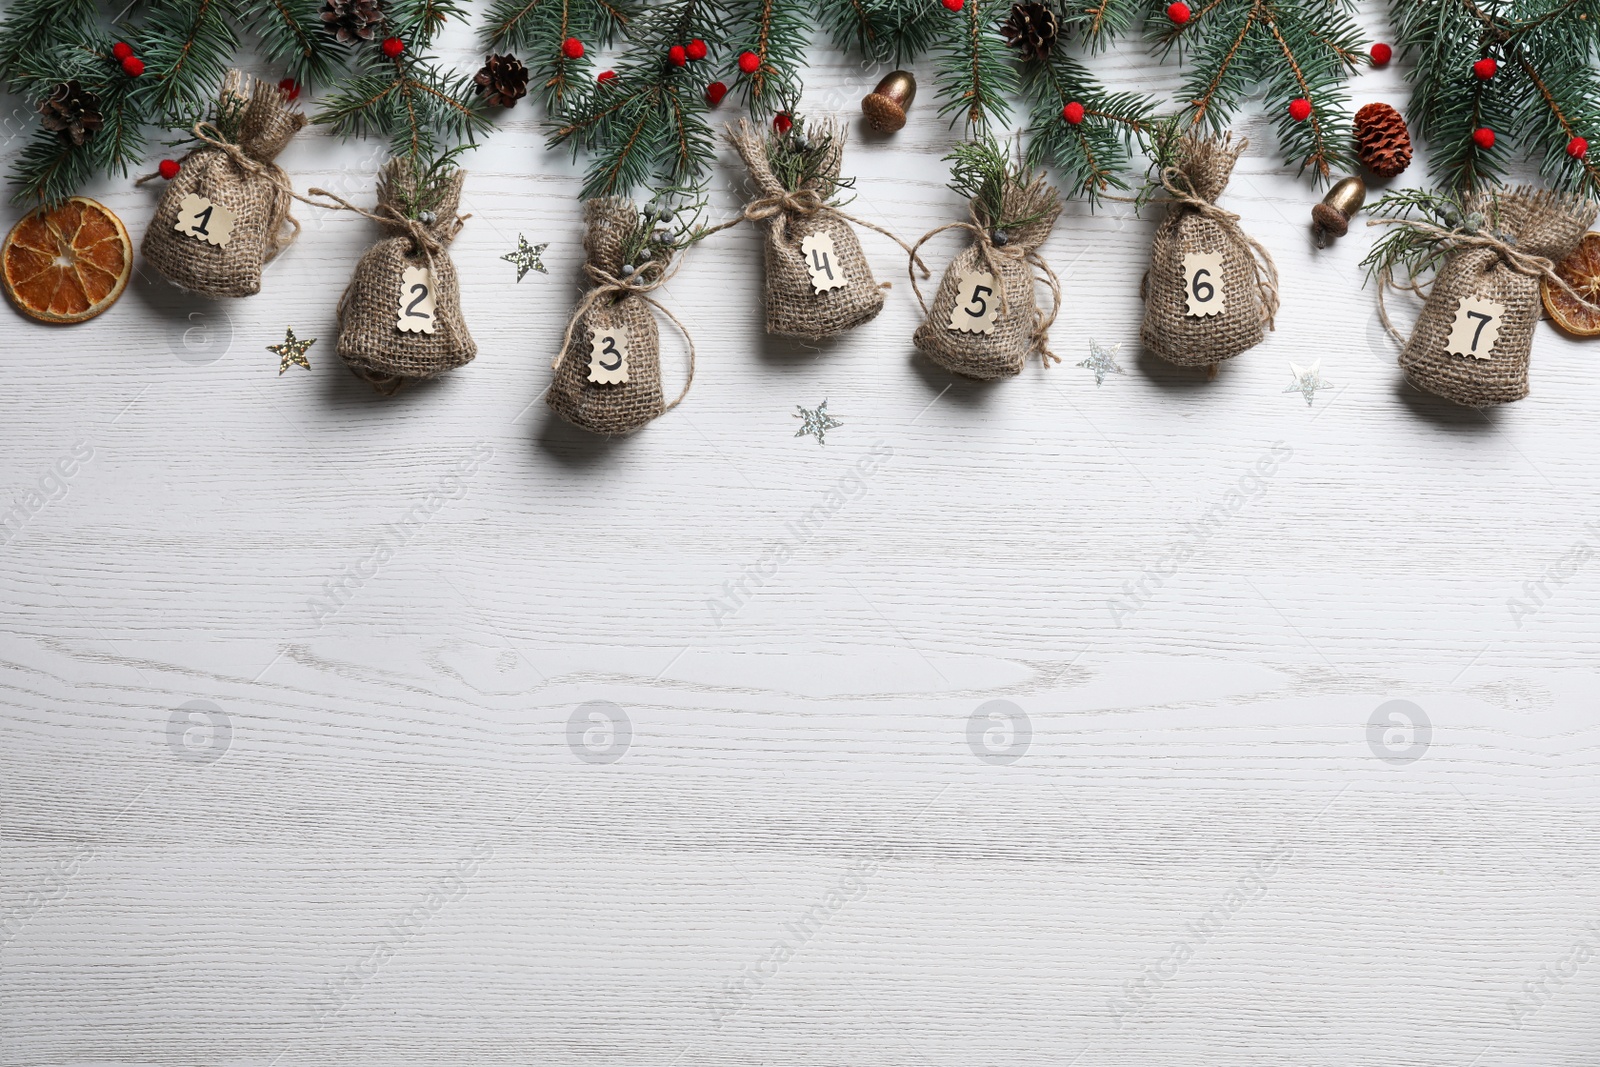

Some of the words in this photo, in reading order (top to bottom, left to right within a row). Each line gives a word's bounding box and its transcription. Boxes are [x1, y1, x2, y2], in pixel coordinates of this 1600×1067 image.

[191, 206, 213, 236] 1
[811, 249, 834, 281] 4
[405, 284, 430, 319] 2
[964, 284, 993, 318] 5
[1192, 268, 1214, 303] 6
[1466, 310, 1493, 352] 7
[598, 336, 623, 371] 3
